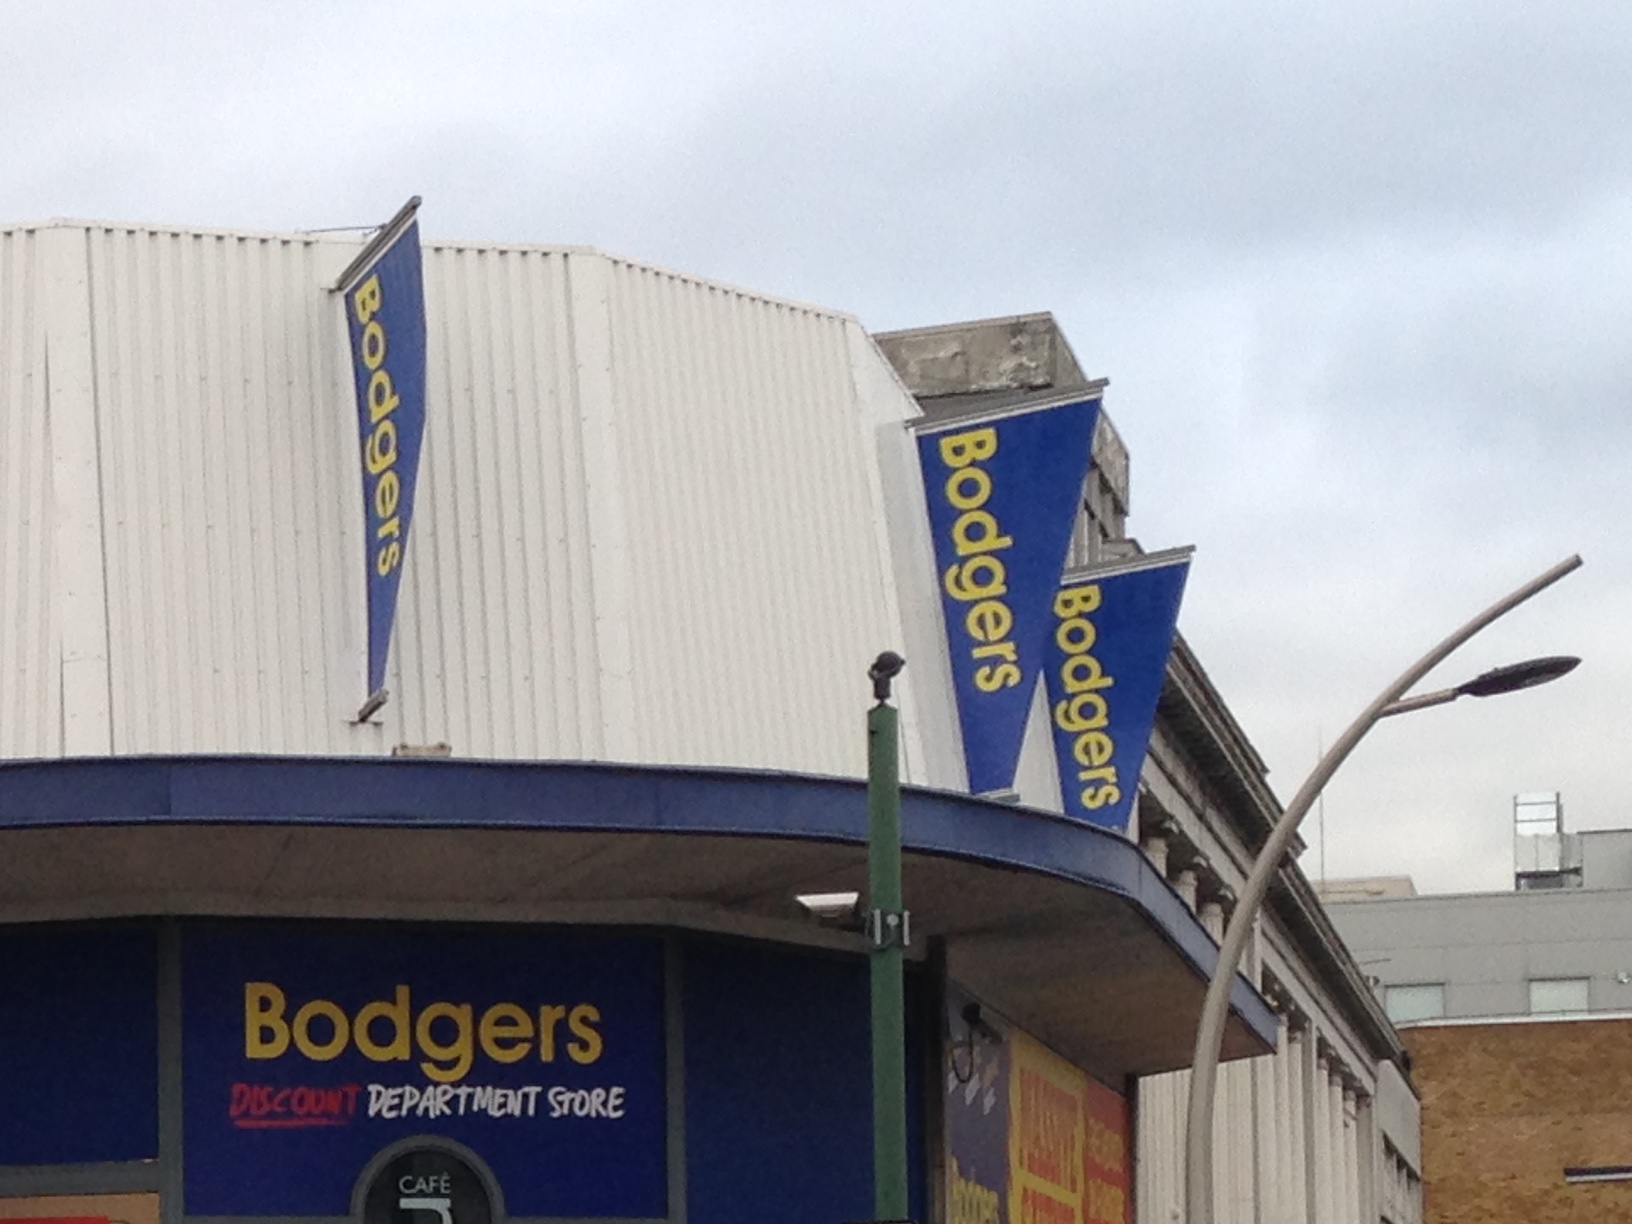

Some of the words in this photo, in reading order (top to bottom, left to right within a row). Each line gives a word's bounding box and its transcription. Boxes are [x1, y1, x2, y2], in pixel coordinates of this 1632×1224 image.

[354, 273, 403, 577] Bodgers
[938, 426, 1024, 694] Bodgers
[1052, 584, 1123, 810] Bodgers
[229, 1082, 361, 1120] DISCOUNT
[367, 1083, 544, 1120] DEPARTMENT
[546, 1085, 627, 1119] STORE
[244, 981, 604, 1083] Bodgers
